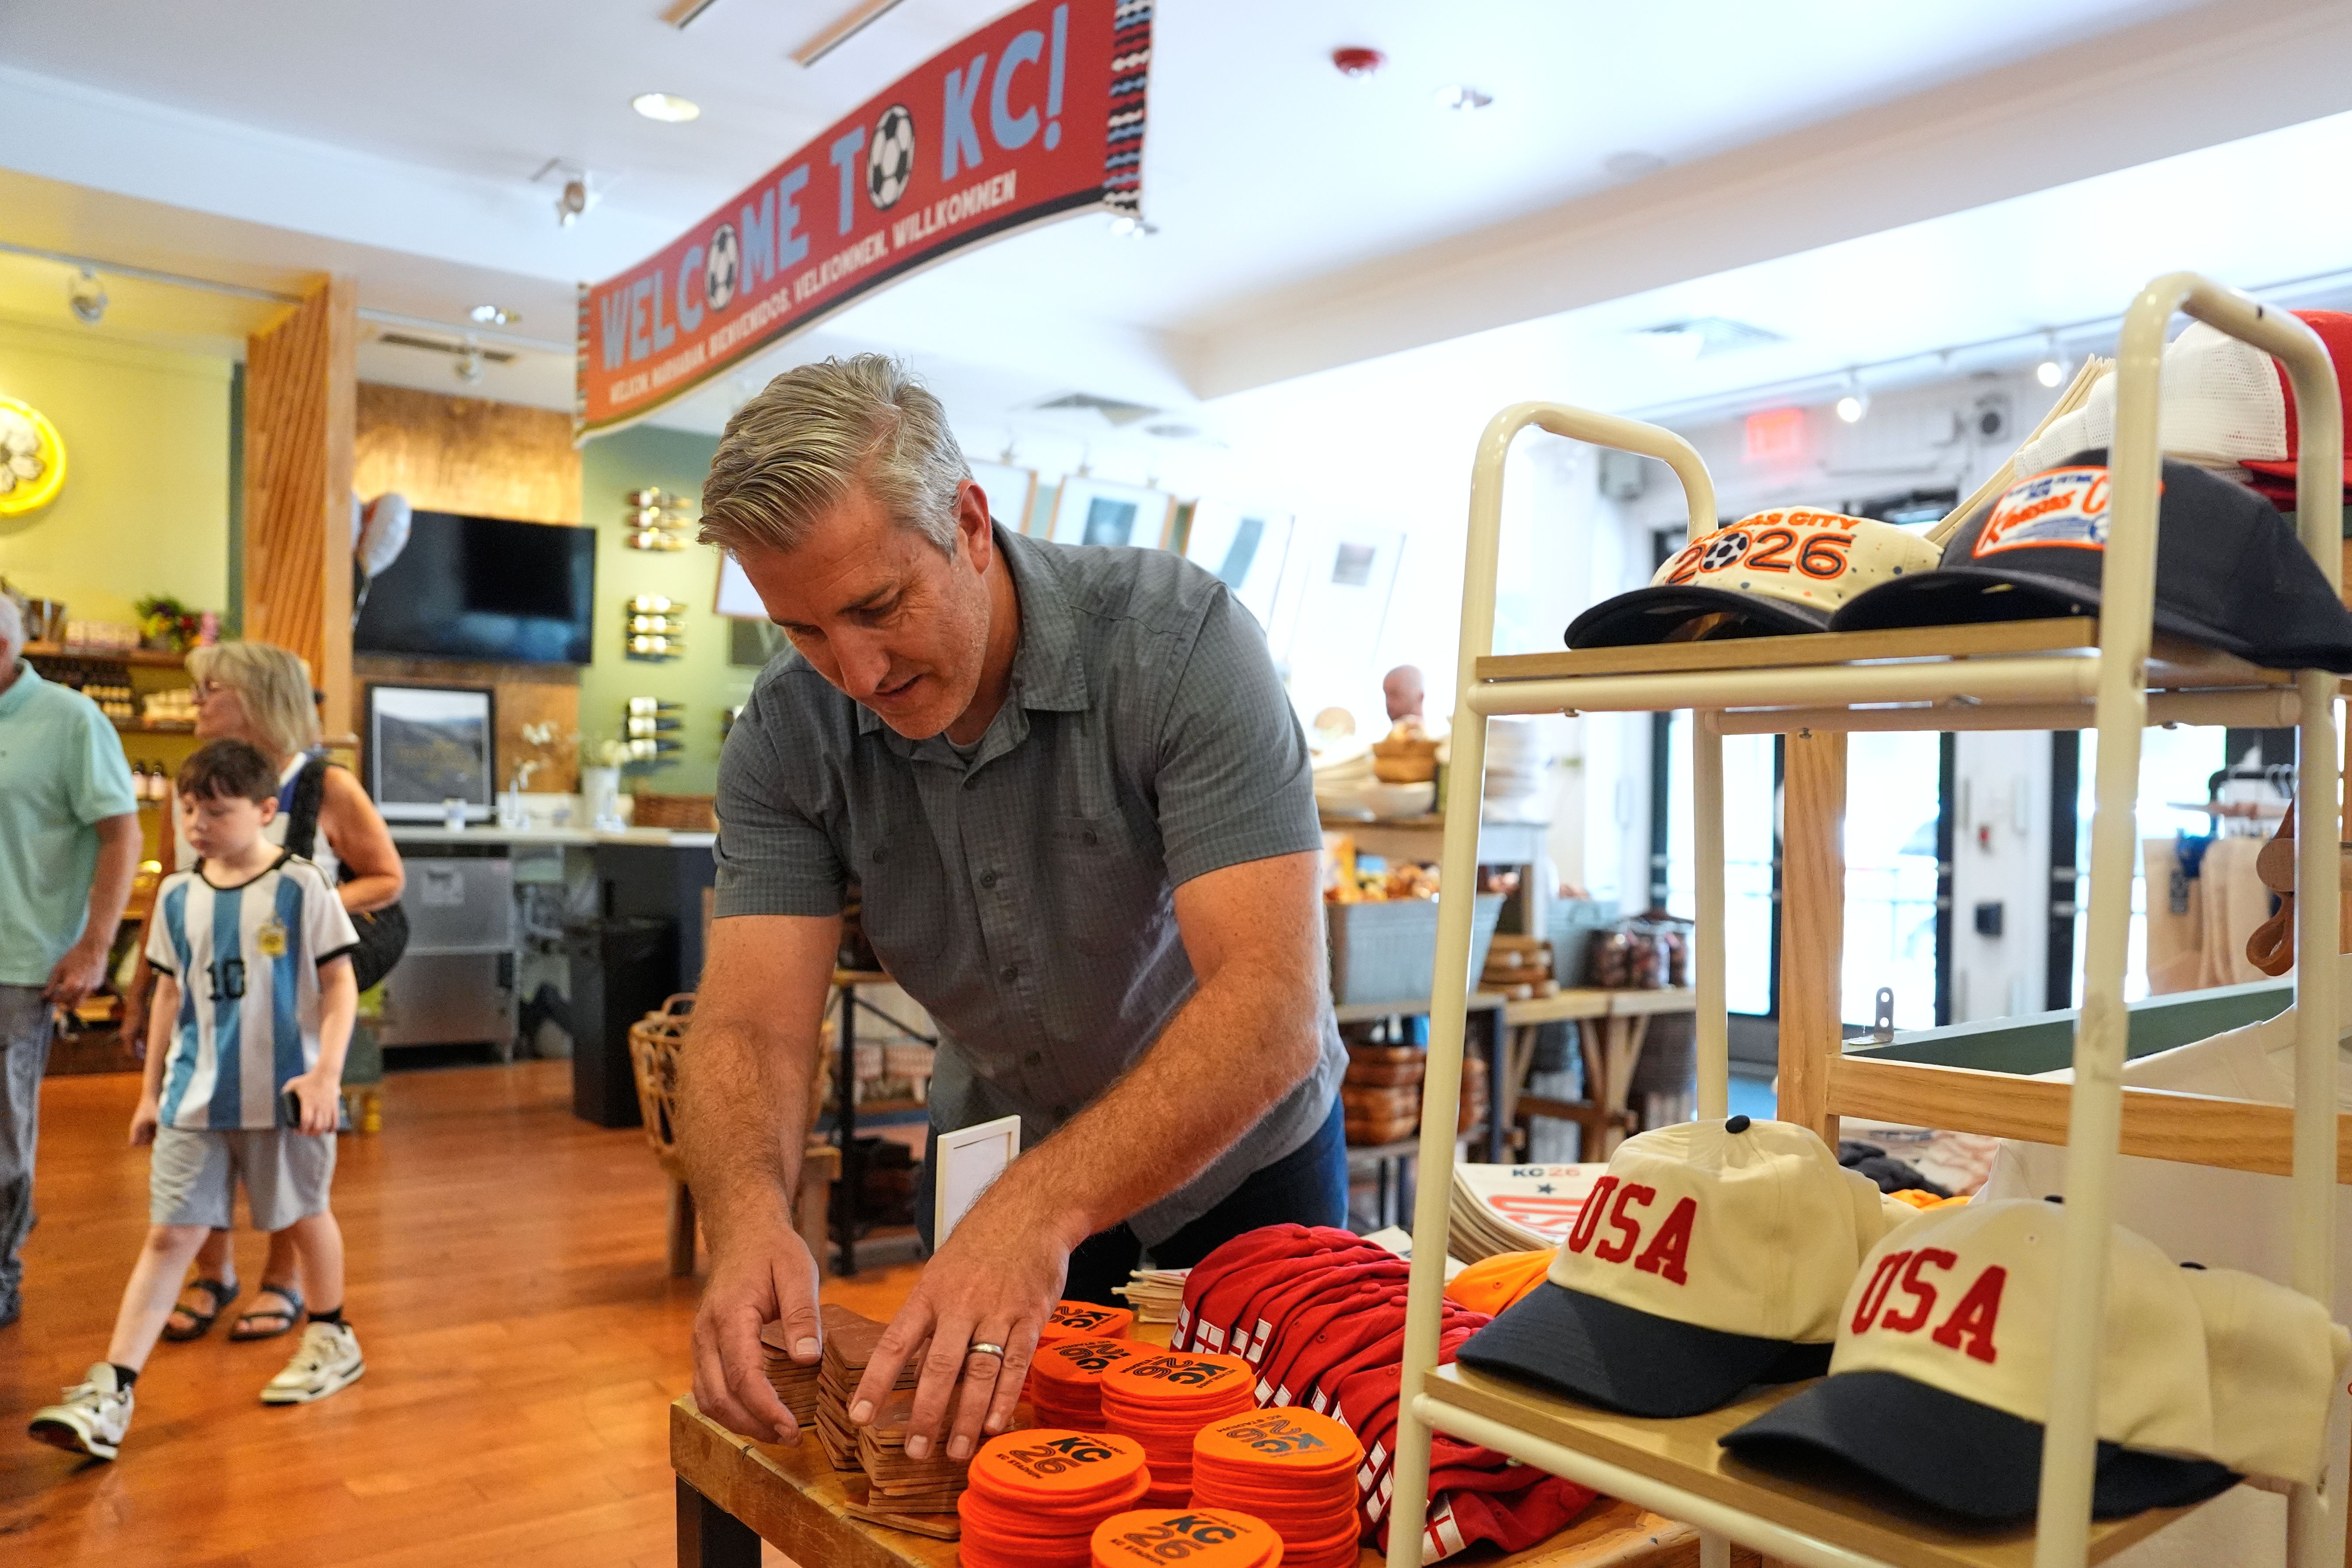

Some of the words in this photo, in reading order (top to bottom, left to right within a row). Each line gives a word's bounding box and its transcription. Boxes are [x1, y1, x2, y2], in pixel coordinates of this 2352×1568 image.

[941, 5, 1069, 182] KC!
[892, 169, 1017, 249] WILLKOMMEN
[1788, 512, 1860, 530] CITY
[1666, 527, 1856, 585] 2026
[206, 960, 245, 1000] 10
[1568, 1175, 1697, 1286] USA
[1851, 1247, 2007, 1364] USA
[1062, 1311, 1113, 1328] KC
[1052, 1342, 1095, 1351] STADIUM
[1059, 1344, 1124, 1360] 26
[1119, 1359, 1153, 1373] STADIUM
[1133, 1357, 1194, 1379] 26
[1168, 1362, 1229, 1384] KC
[1196, 1369, 1238, 1388] NETHERLANDS
[1216, 1419, 1265, 1432] STADIUM
[1227, 1419, 1302, 1443] 26
[1046, 1437, 1112, 1462] KC
[1251, 1433, 1326, 1453] KC
[1007, 1460, 1043, 1479] STADIUM
[1009, 1445, 1082, 1474] 26
[1163, 1515, 1237, 1544] KC
[1123, 1526, 1206, 1559] 26
